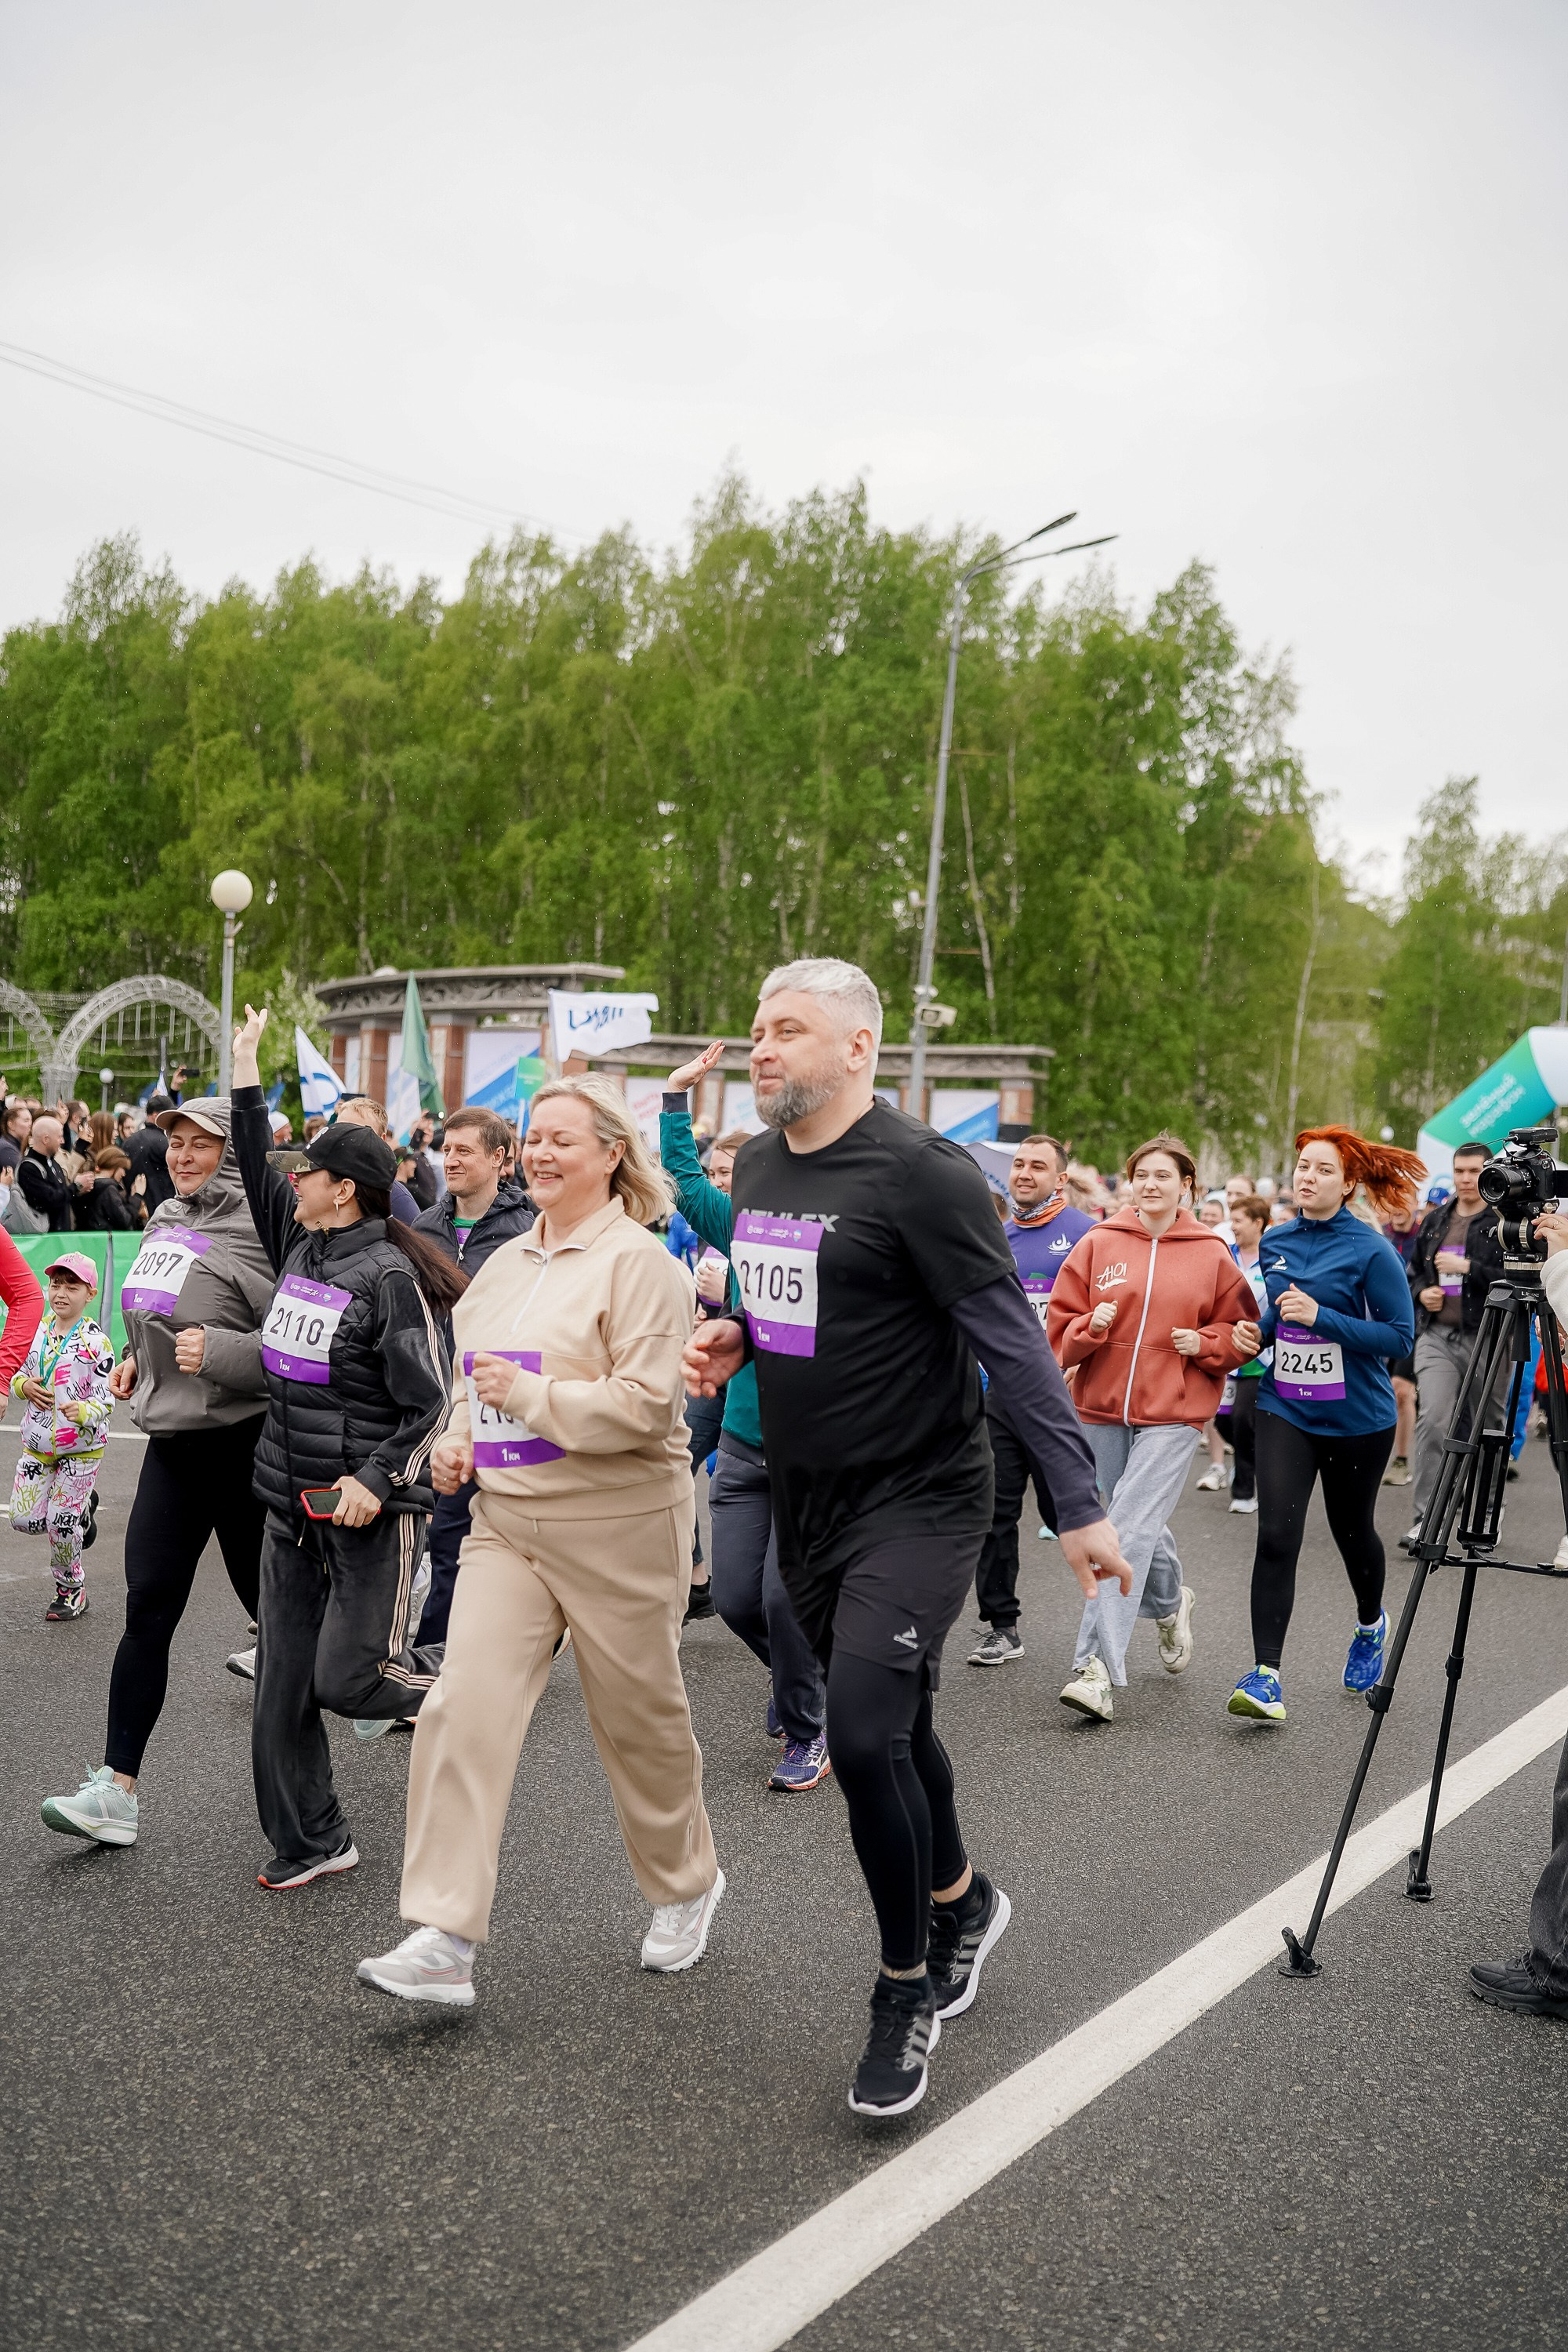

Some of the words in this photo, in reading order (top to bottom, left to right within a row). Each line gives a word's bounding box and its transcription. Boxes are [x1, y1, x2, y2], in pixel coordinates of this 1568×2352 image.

[132, 1251, 183, 1277] 2097
[740, 1260, 803, 1303] 2105
[269, 1307, 325, 1346] 2110
[1281, 1352, 1334, 1374] 2245
